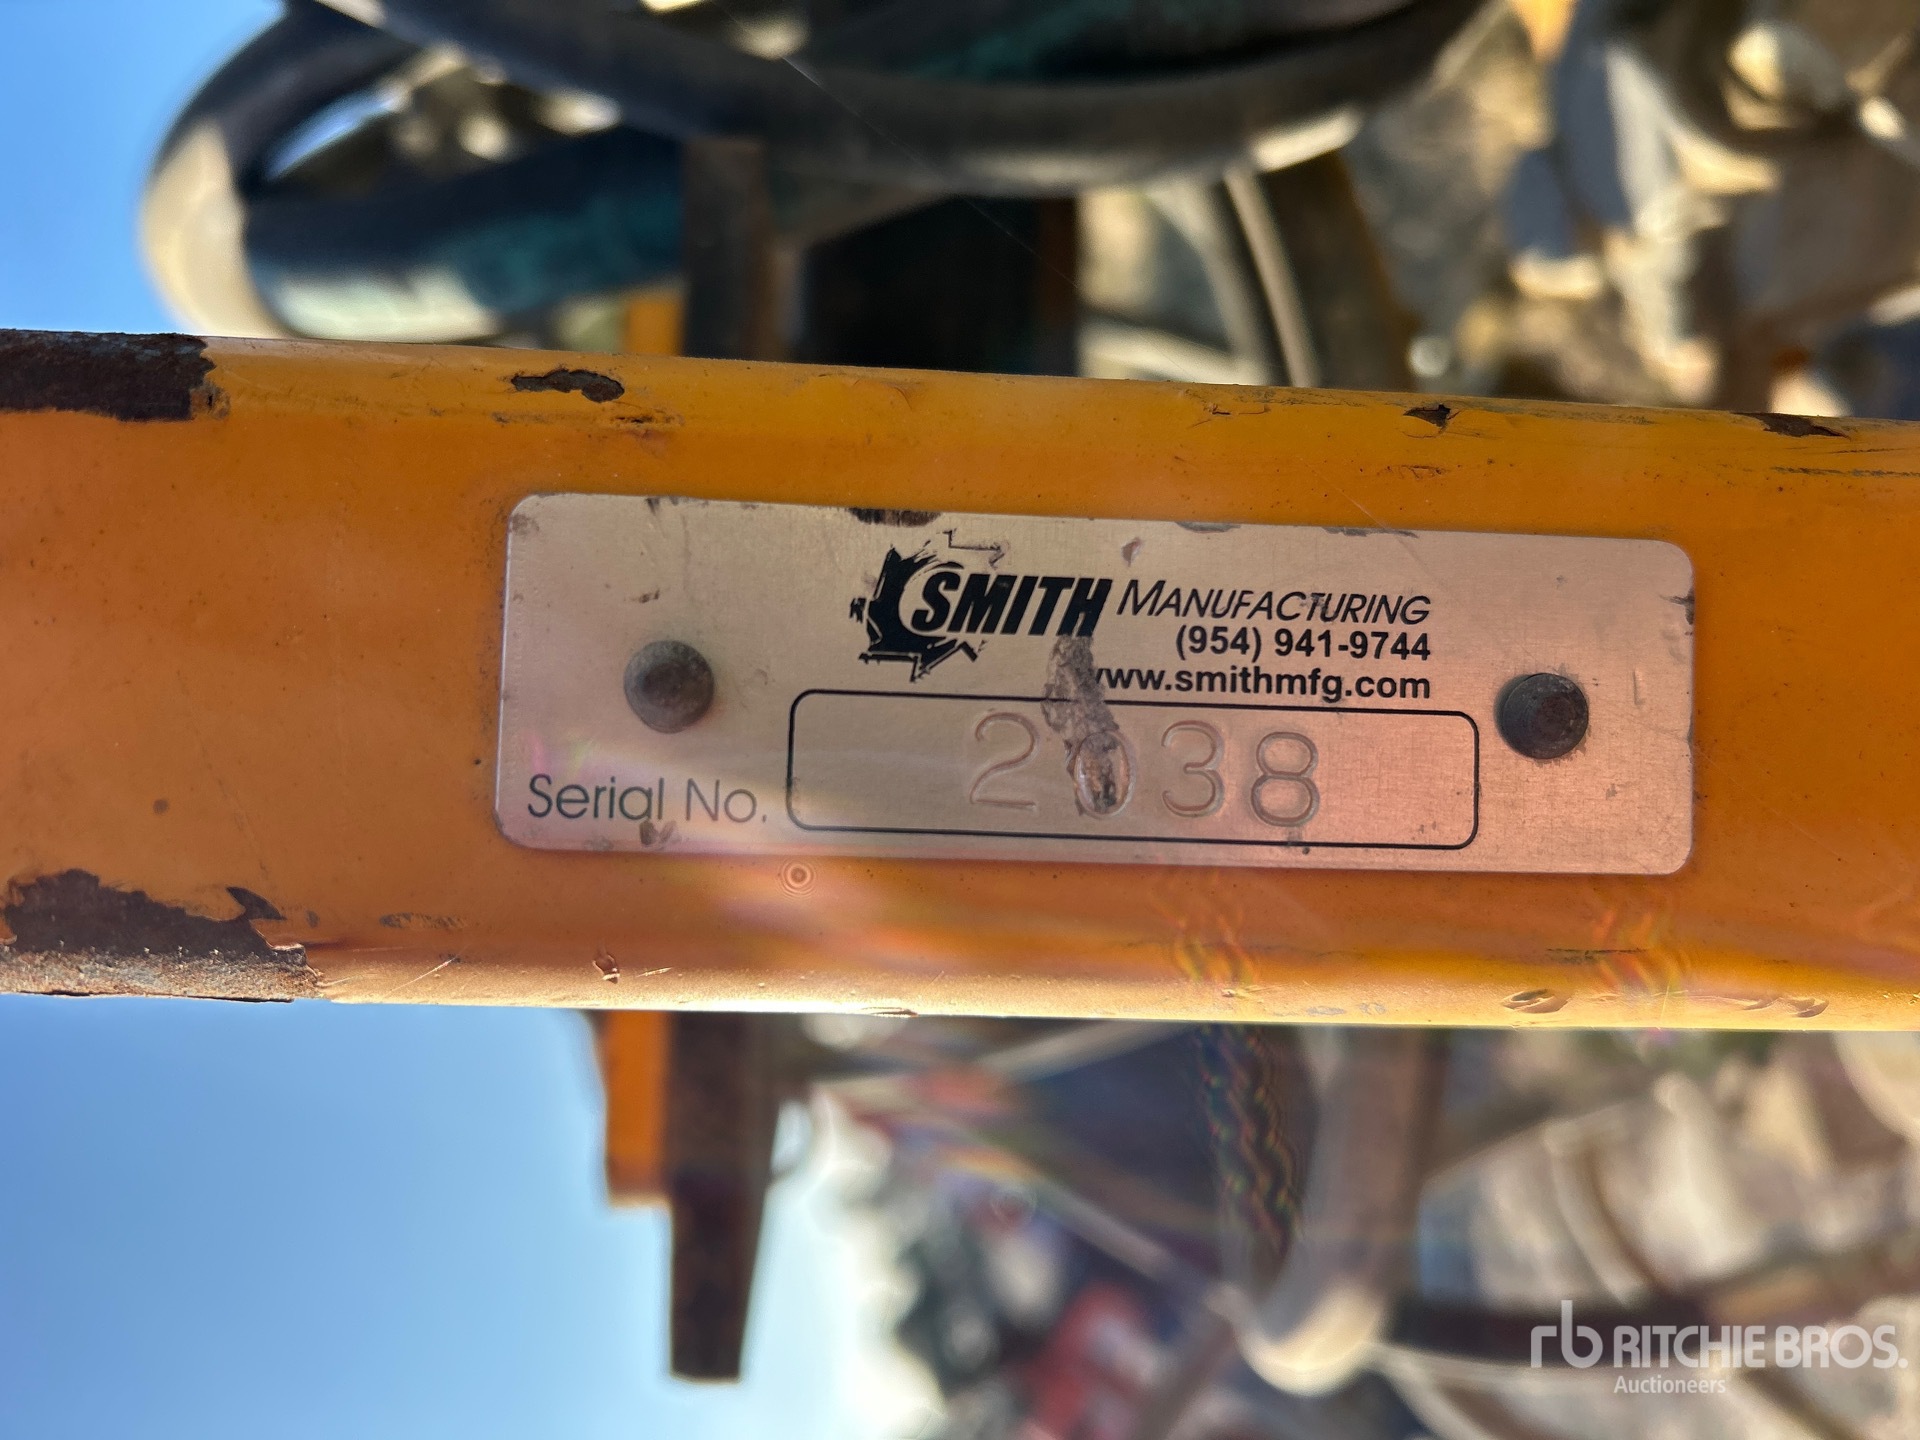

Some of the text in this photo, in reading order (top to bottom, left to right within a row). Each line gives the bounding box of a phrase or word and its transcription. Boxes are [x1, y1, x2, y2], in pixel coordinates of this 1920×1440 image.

[911, 573, 1112, 637] SMITH
[1175, 625, 1431, 662] (954) 941-9744
[1094, 665, 1432, 702] ww.smithmfg.com
[528, 711, 1321, 827] Serial No. 2038
